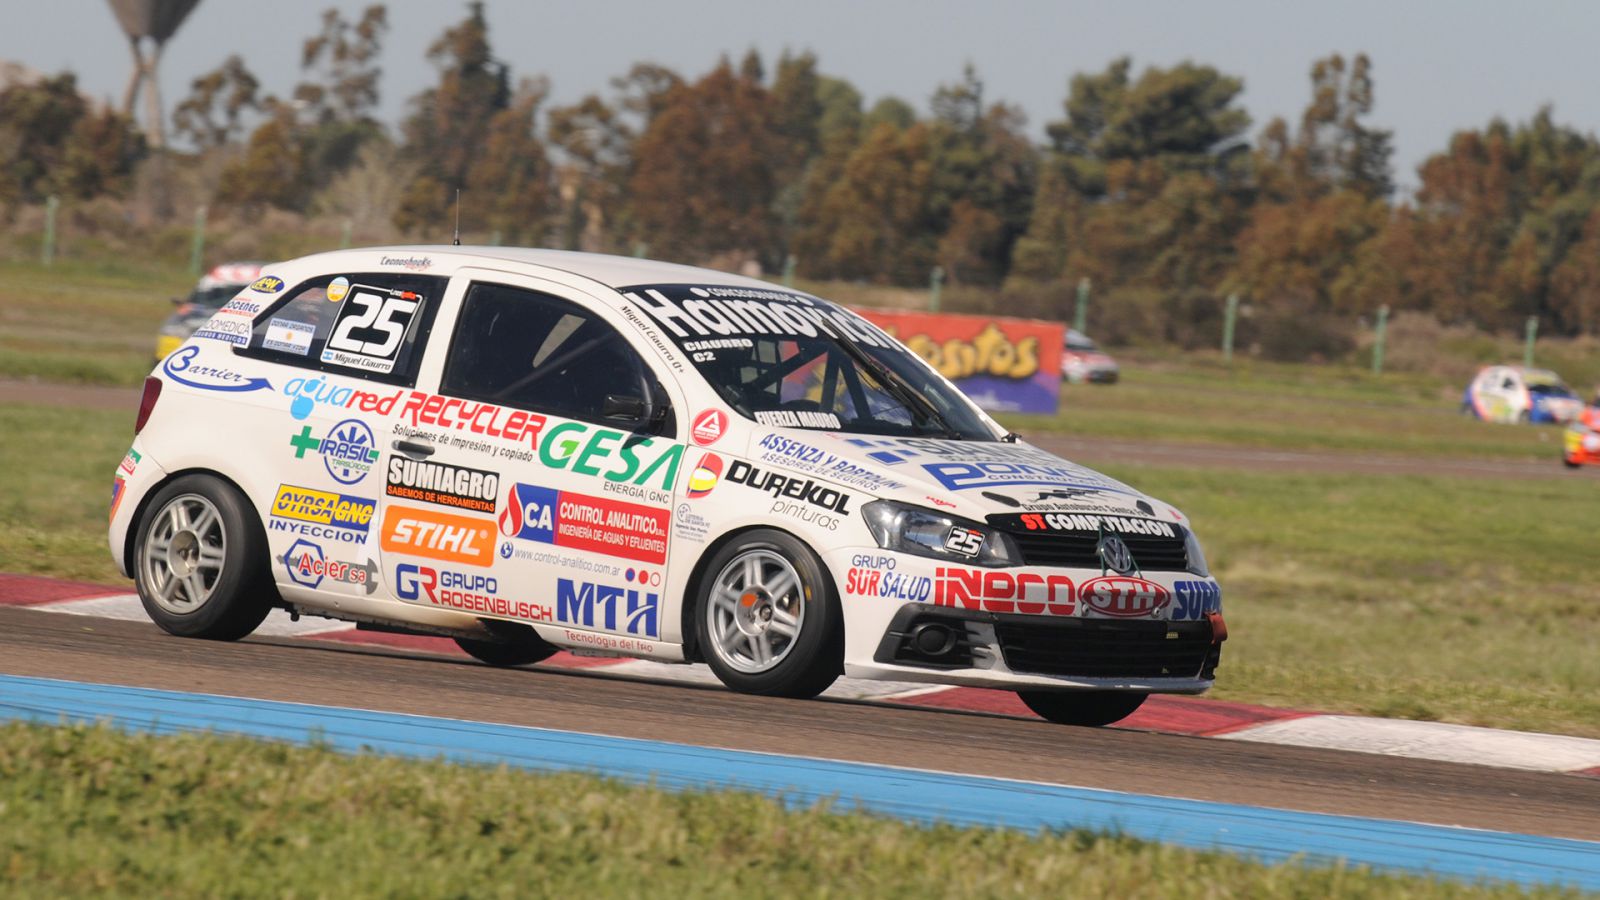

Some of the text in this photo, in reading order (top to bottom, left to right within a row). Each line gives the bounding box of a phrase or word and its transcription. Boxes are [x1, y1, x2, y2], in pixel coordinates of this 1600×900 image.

[329, 292, 418, 357] 25
[621, 306, 650, 331] Miguel
[646, 328, 675, 361] Ciaurro
[623, 289, 904, 353] Haimovich
[684, 339, 753, 351] CIAURRO
[692, 351, 716, 362] C2
[334, 353, 391, 370] Miguel Ciaurro
[754, 411, 841, 429] FUERZA MAURO
[392, 424, 436, 441] Soluciones
[438, 433, 449, 444] de
[492, 446, 498, 457] y
[499, 447, 533, 462] copiado
[539, 422, 685, 491] GESA
[759, 433, 823, 463] ASSENZA
[823, 455, 837, 466] Y
[388, 457, 498, 500] SUMIAGRO
[761, 452, 882, 491] ASESORES DE SEGUROS
[387, 485, 495, 512] SABEMOS DE HERRAMIENTAS
[649, 490, 669, 504] GNC
[725, 460, 850, 516] DUREKOL
[524, 503, 553, 531] CA
[560, 502, 605, 525] CONTROL
[606, 511, 657, 534] ANALITICO
[770, 500, 839, 531] pinturas
[1022, 503, 1054, 512] Grupo
[269, 520, 367, 545] INYECCION
[390, 519, 480, 556] STIHL
[1020, 514, 1048, 530] ST
[1045, 514, 1175, 538] COMPUTACION
[593, 529, 602, 541] DE
[603, 532, 624, 545] AGUAS
[625, 535, 630, 546] Y
[630, 536, 665, 553] EFLUENTES
[946, 529, 982, 554] 25
[299, 553, 366, 583] Acier sa
[852, 554, 896, 570] GRUPO
[396, 563, 439, 604] GR
[441, 571, 497, 594] GRUPO
[1091, 582, 1156, 609] STH
[441, 590, 552, 622] ROSENBUSCH
[557, 577, 658, 638] MTH
[620, 637, 634, 649] del
